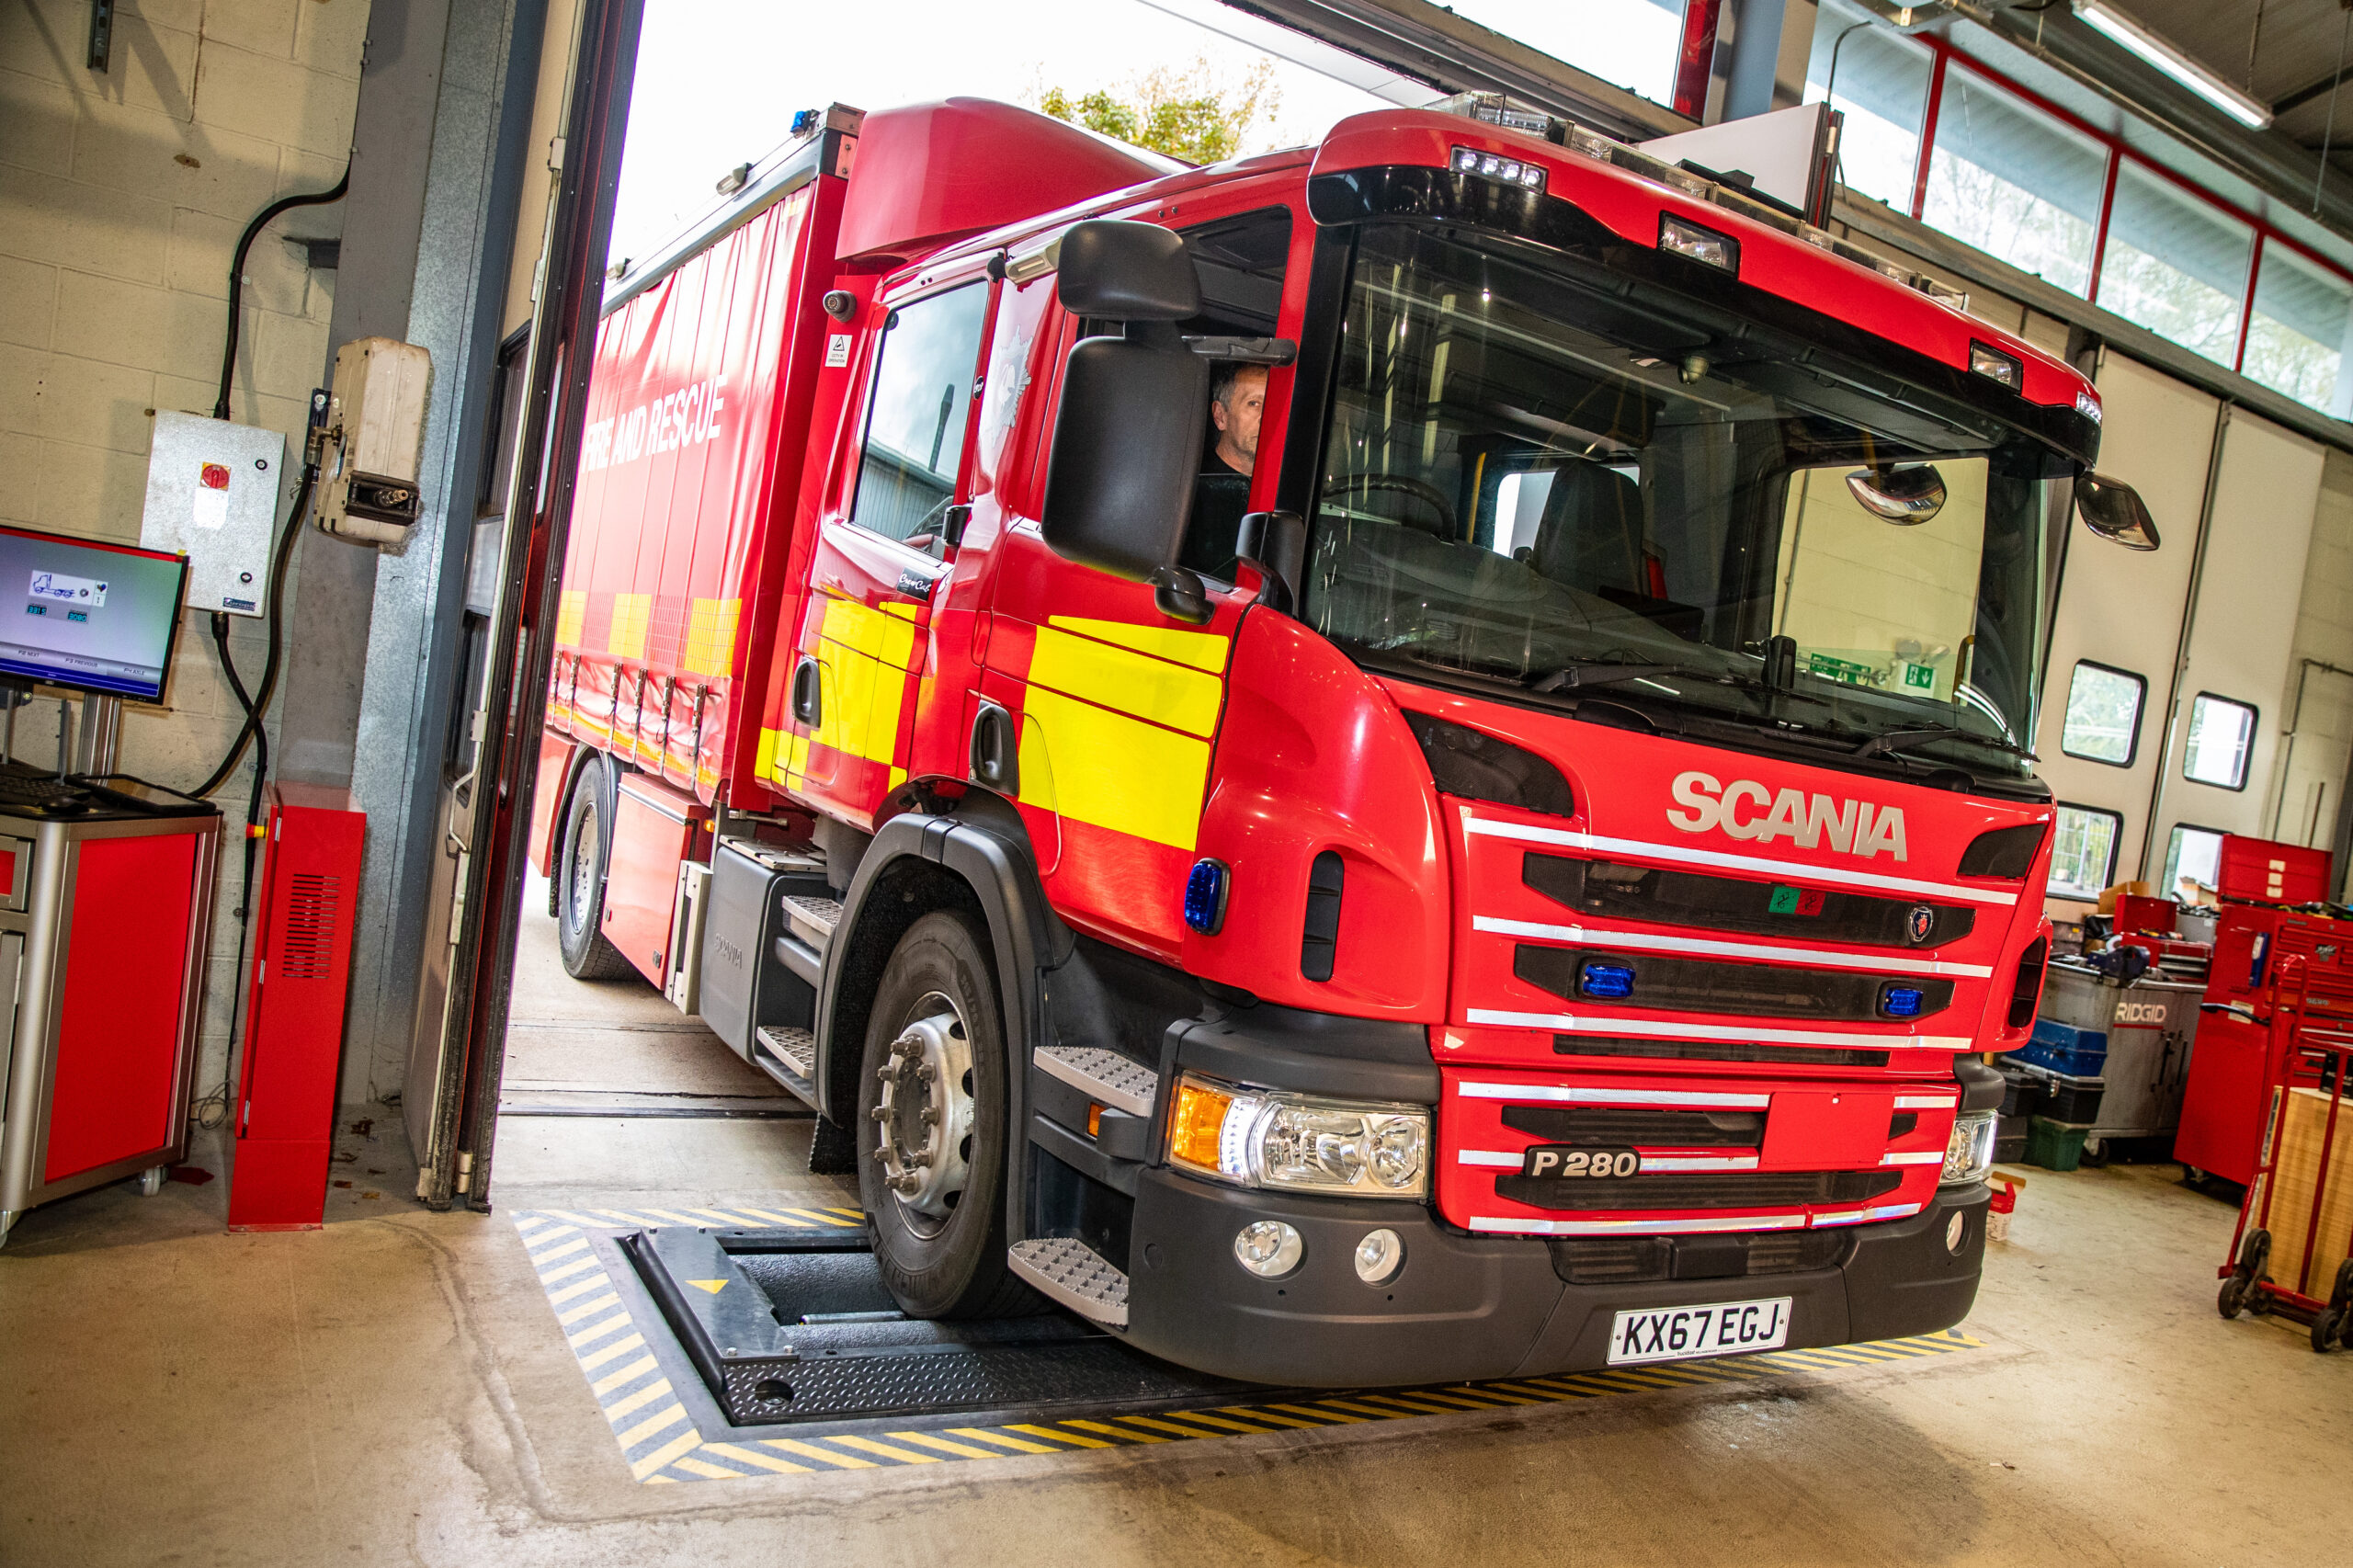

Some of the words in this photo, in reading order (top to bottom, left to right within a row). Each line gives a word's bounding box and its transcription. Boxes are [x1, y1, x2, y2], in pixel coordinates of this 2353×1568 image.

[581, 416, 615, 473] FIRE
[610, 404, 647, 466] AND
[645, 373, 729, 456] RESCUE
[1665, 770, 1908, 862] SCANIA
[714, 933, 743, 971] SCANIA
[2115, 1002, 2167, 1022] RIDGID
[1532, 1152, 1559, 1176] P
[1563, 1152, 1637, 1177] 280
[1622, 1311, 1712, 1356] KX67
[1718, 1303, 1779, 1346] EGJ
